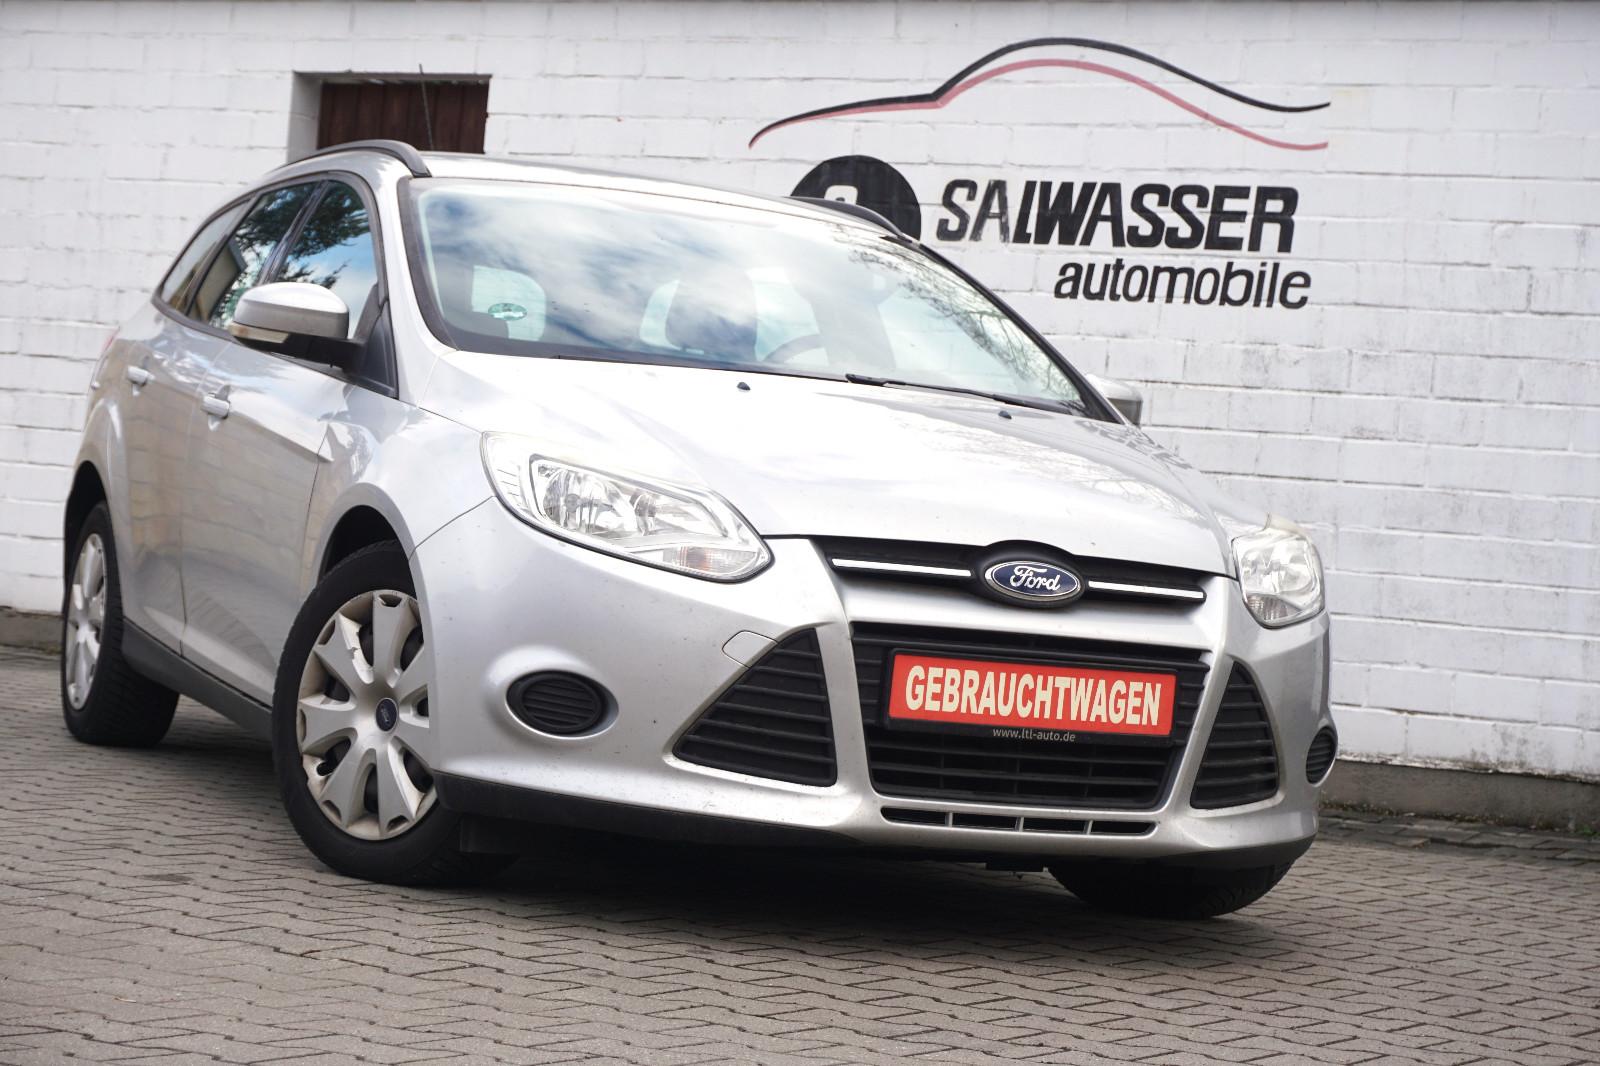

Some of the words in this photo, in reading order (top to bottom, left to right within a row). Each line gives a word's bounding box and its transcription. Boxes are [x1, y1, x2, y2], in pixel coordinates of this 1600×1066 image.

[936, 178, 1300, 254] SALWASSER
[1054, 257, 1312, 309] automobile
[1009, 565, 1061, 591] Ford
[905, 665, 1162, 726] GEBRAUCHTWAGEN
[992, 728, 1076, 742] www.ltl-auto.de
